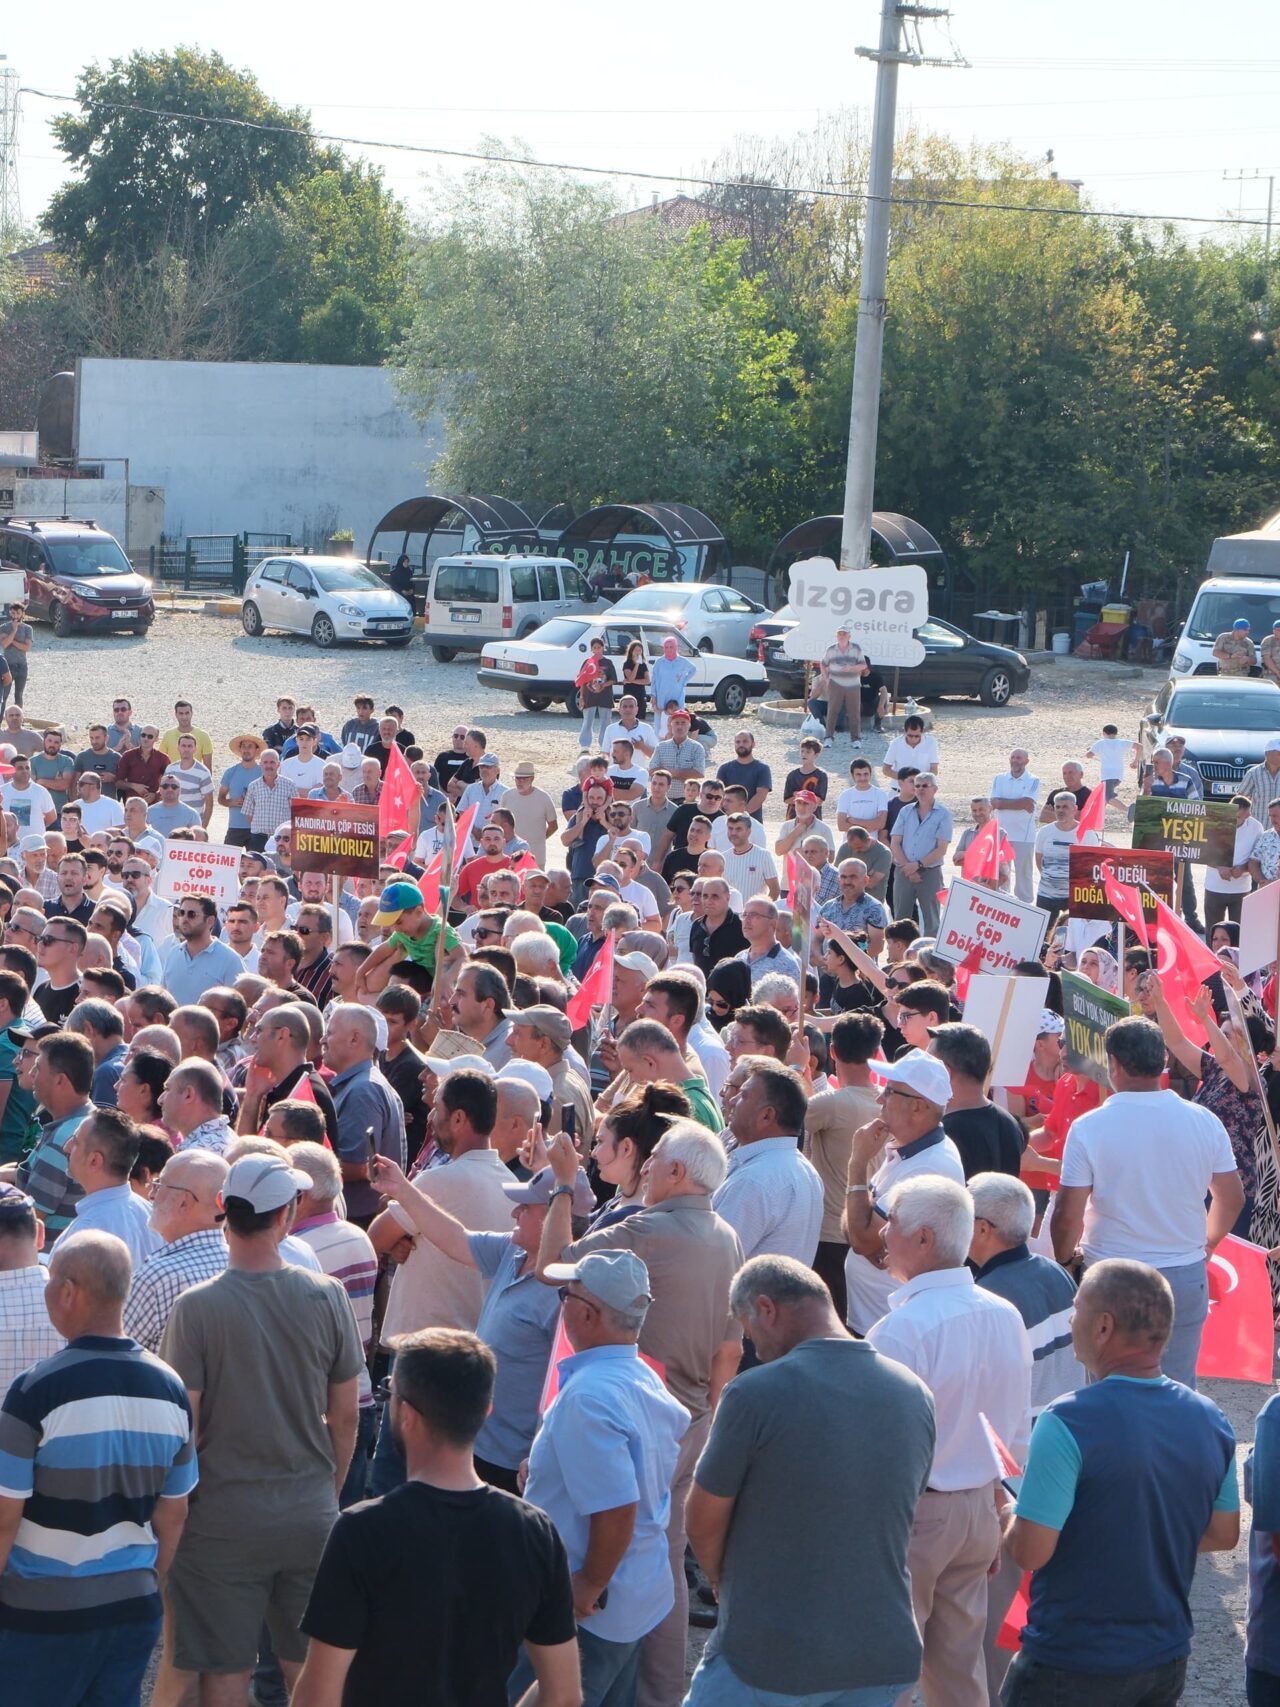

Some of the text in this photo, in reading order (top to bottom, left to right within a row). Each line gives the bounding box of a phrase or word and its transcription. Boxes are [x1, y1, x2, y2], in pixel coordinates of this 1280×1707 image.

[795, 579, 915, 616] Izgara
[1166, 801, 1207, 816] KANDIRA
[294, 816, 376, 836] KANDIRA'DA ÇÖP TESİSİ
[1161, 818, 1208, 844] YEŞİL
[296, 830, 374, 858] İSTEMİYORUZ!
[1164, 845, 1201, 859] KALSIN!
[189, 866, 212, 880] ÇÖP
[1117, 864, 1150, 884] DEĞİL
[173, 880, 216, 896] DÖKME
[1074, 884, 1103, 905] DOĞA
[969, 896, 1021, 928] Tarıma
[976, 920, 1002, 946] Çöp
[1069, 1017, 1091, 1059] YOK
